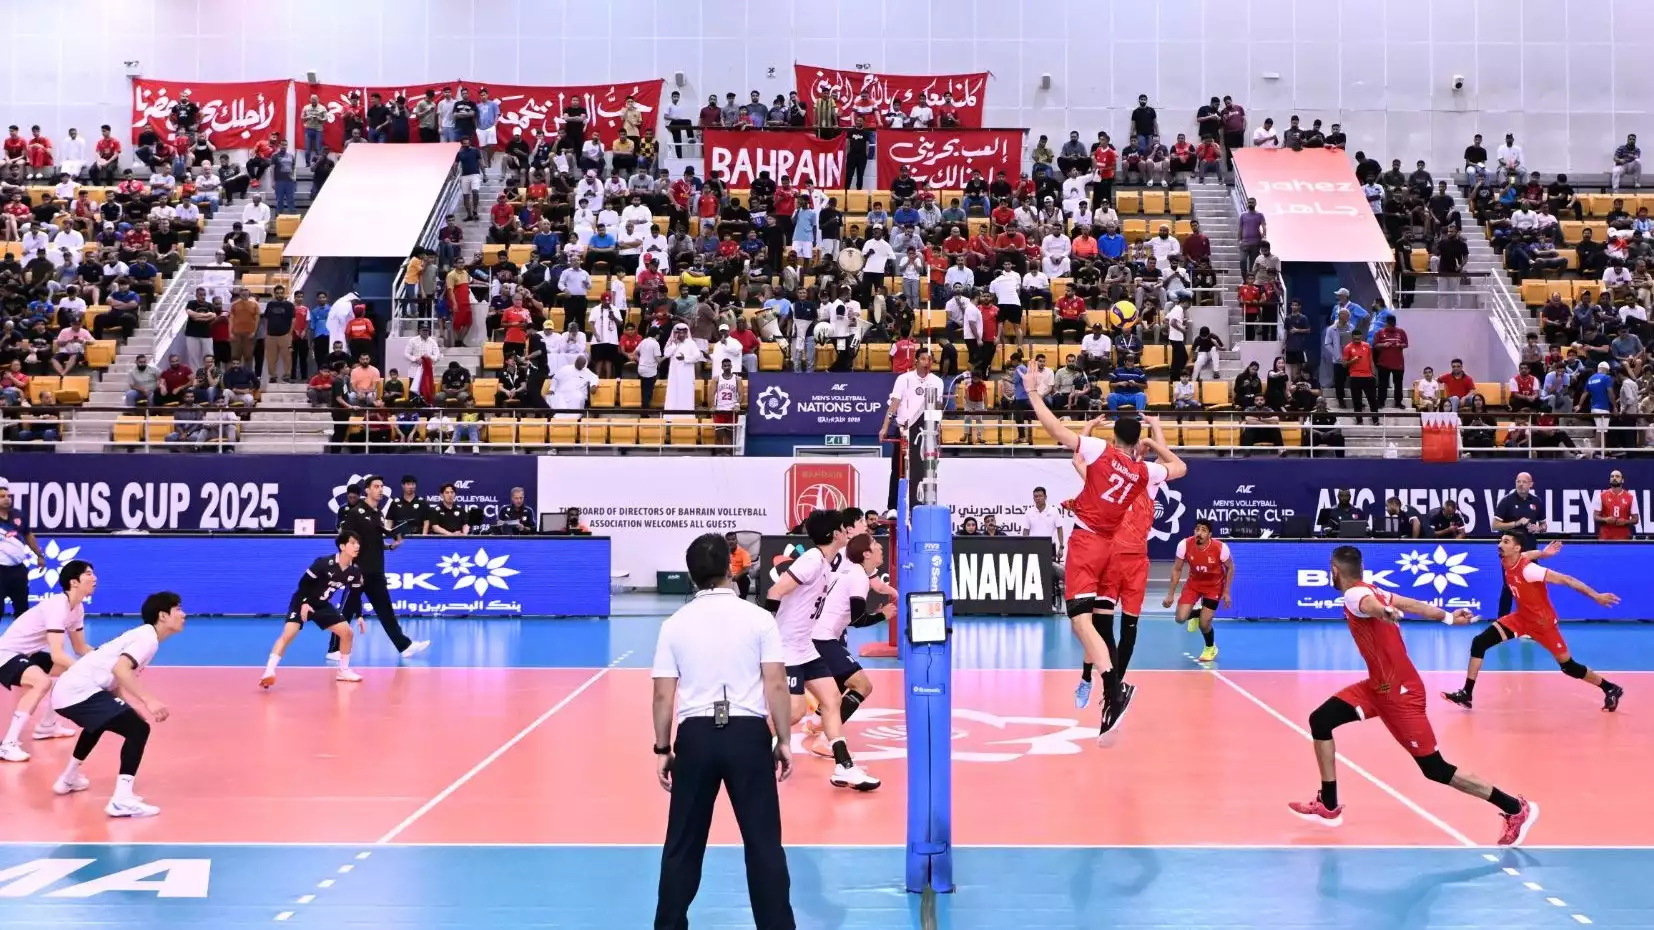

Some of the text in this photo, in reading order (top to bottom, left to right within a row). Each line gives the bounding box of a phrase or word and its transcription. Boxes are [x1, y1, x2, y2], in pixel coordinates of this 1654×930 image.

[210, 92, 275, 139] لأجلك
[712, 147, 844, 188] BAHRAIN
[721, 391, 733, 401] 23
[797, 402, 881, 413] NATIONS CUP
[1101, 473, 1134, 504] 21
[1236, 485, 1255, 493] AVC
[121, 481, 190, 529] CUP
[199, 482, 279, 529] 2025
[1213, 499, 1277, 507] MEN'S VOLLEYBALL
[606, 507, 617, 516] OF
[619, 507, 664, 516] DIRECTORS
[666, 507, 677, 516] OF
[678, 507, 715, 516] BAHRAIN
[717, 507, 767, 516] VOLLEYBALL
[958, 503, 1003, 518] البحريني
[1196, 509, 1260, 522] NATIONS
[1613, 505, 1620, 518] 8
[590, 519, 737, 529] ASSOCIATION WELCOMES ALL GUESTS
[1297, 569, 1400, 587] BK
[486, 600, 522, 613] بنك
